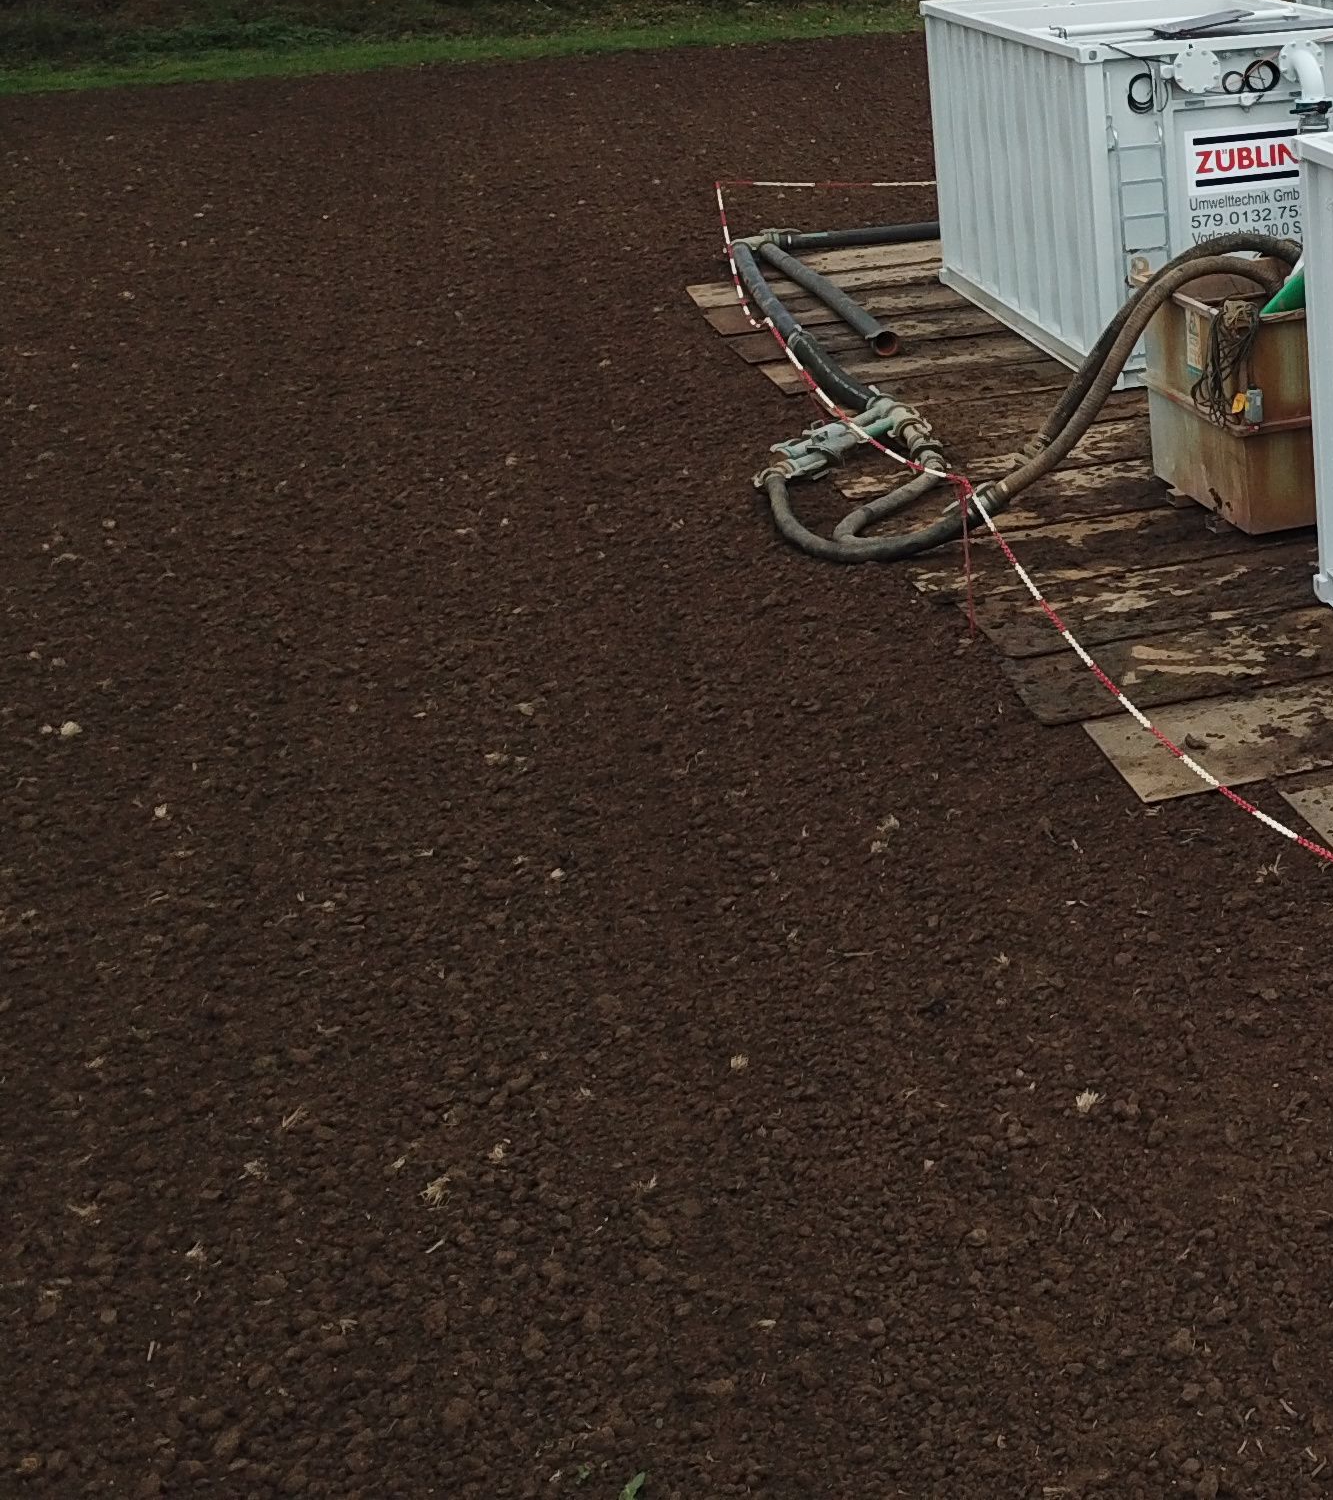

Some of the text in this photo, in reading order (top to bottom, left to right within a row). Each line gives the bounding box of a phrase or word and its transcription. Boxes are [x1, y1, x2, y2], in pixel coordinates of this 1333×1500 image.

[1195, 143, 1299, 175] ZÜBLIN
[1190, 188, 1300, 211] Umwelttechnik Gmb
[1191, 205, 1302, 229] 579.0132.75
[1293, 221, 1302, 234] S
